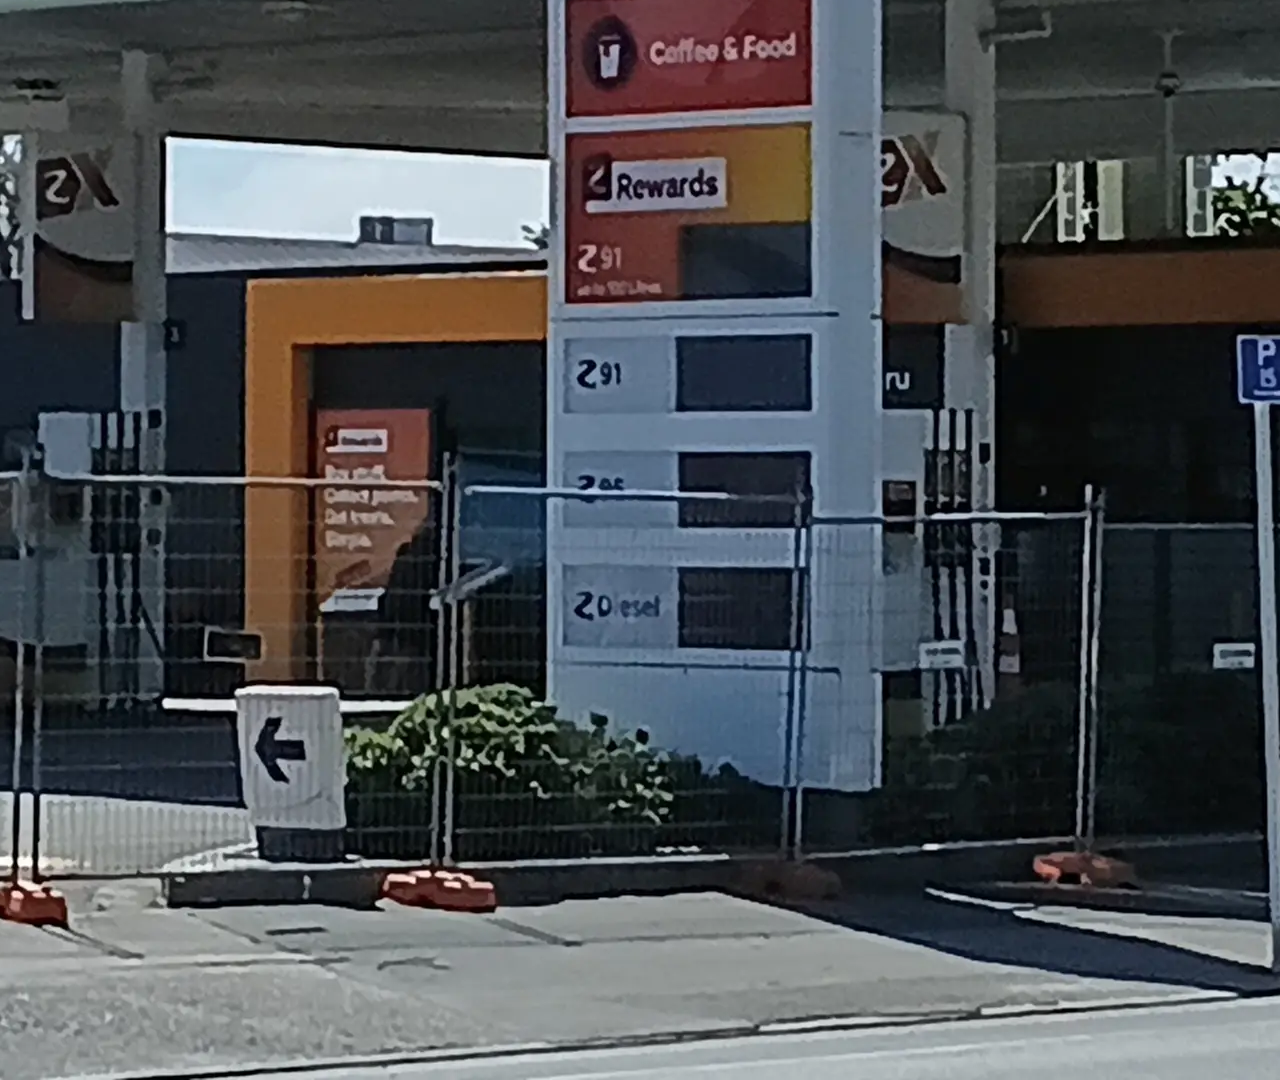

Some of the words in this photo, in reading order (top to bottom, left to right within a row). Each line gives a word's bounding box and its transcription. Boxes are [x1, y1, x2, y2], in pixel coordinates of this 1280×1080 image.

[649, 36, 719, 66] Coffee
[722, 35, 738, 62] &
[742, 31, 798, 60] Food
[616, 167, 719, 201] Rewards
[1257, 339, 1277, 366] P
